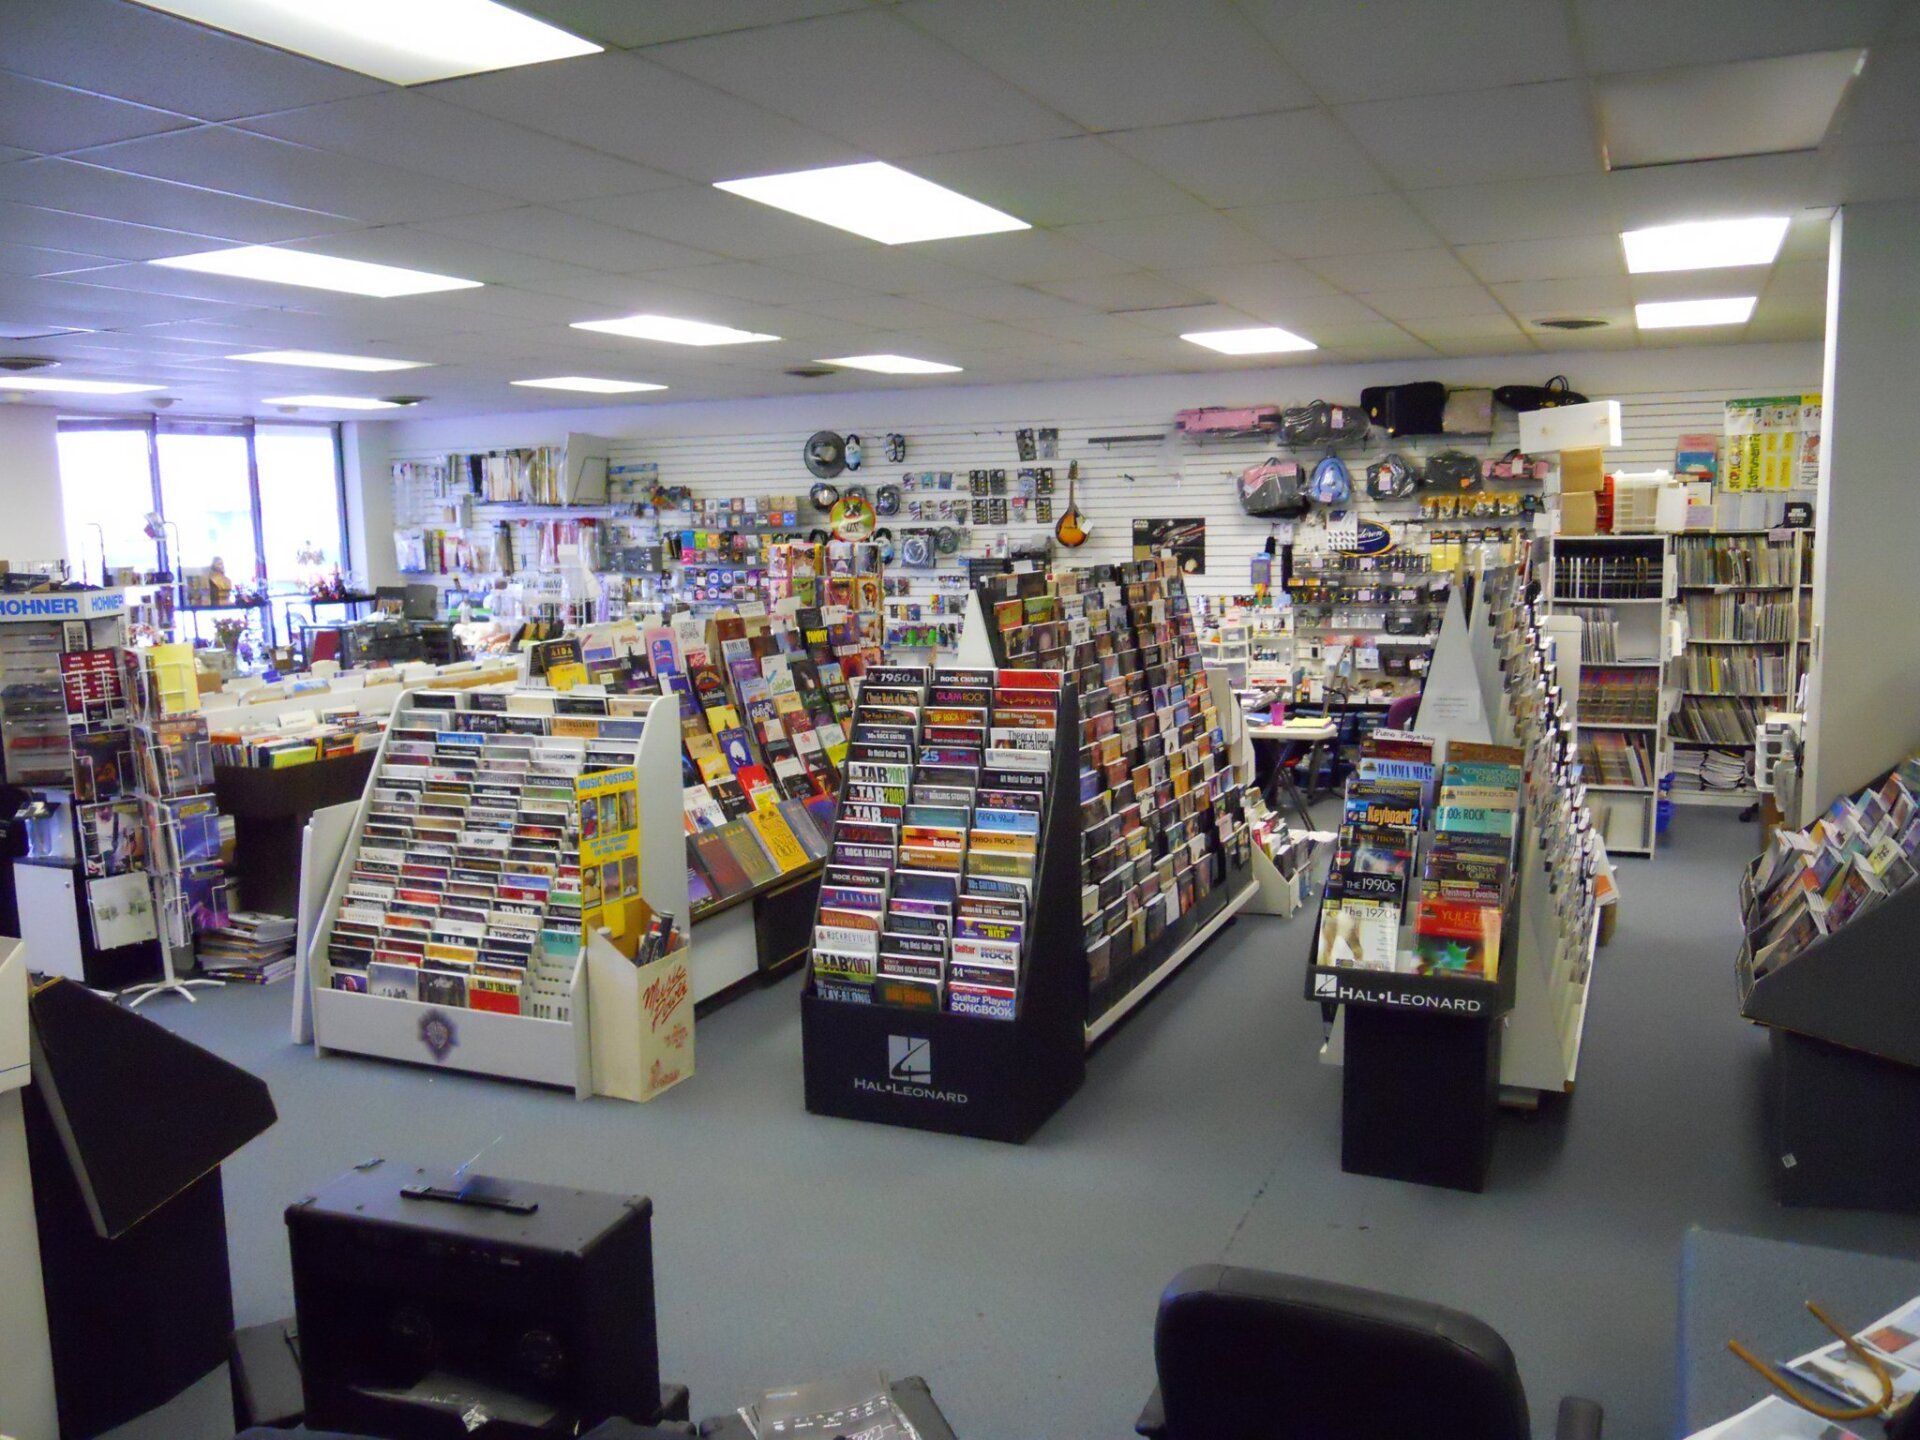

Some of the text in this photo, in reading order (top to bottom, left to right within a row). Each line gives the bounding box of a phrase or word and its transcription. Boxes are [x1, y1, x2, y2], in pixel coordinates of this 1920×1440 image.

[1008, 730, 1033, 742] Theory
[921, 750, 939, 761] 25
[859, 766, 887, 783] TAB
[1378, 763, 1410, 778] MAMMA
[579, 771, 634, 789] MUSIC POSTERS
[857, 786, 884, 803] TAB
[853, 806, 881, 823] TAB
[1367, 805, 1419, 826] Keyboard 2
[1463, 809, 1486, 820] ROCK
[994, 837, 1016, 845] ROCK
[1362, 877, 1396, 892] 1990s
[1344, 905, 1362, 917] The
[987, 929, 1006, 939] HITS
[820, 953, 848, 971] TAB
[980, 952, 1013, 960] ROCK
[479, 979, 517, 993] BILLY TALENT
[952, 992, 1011, 1008] Guitar Player
[951, 1002, 1014, 1017] SONGBOOK
